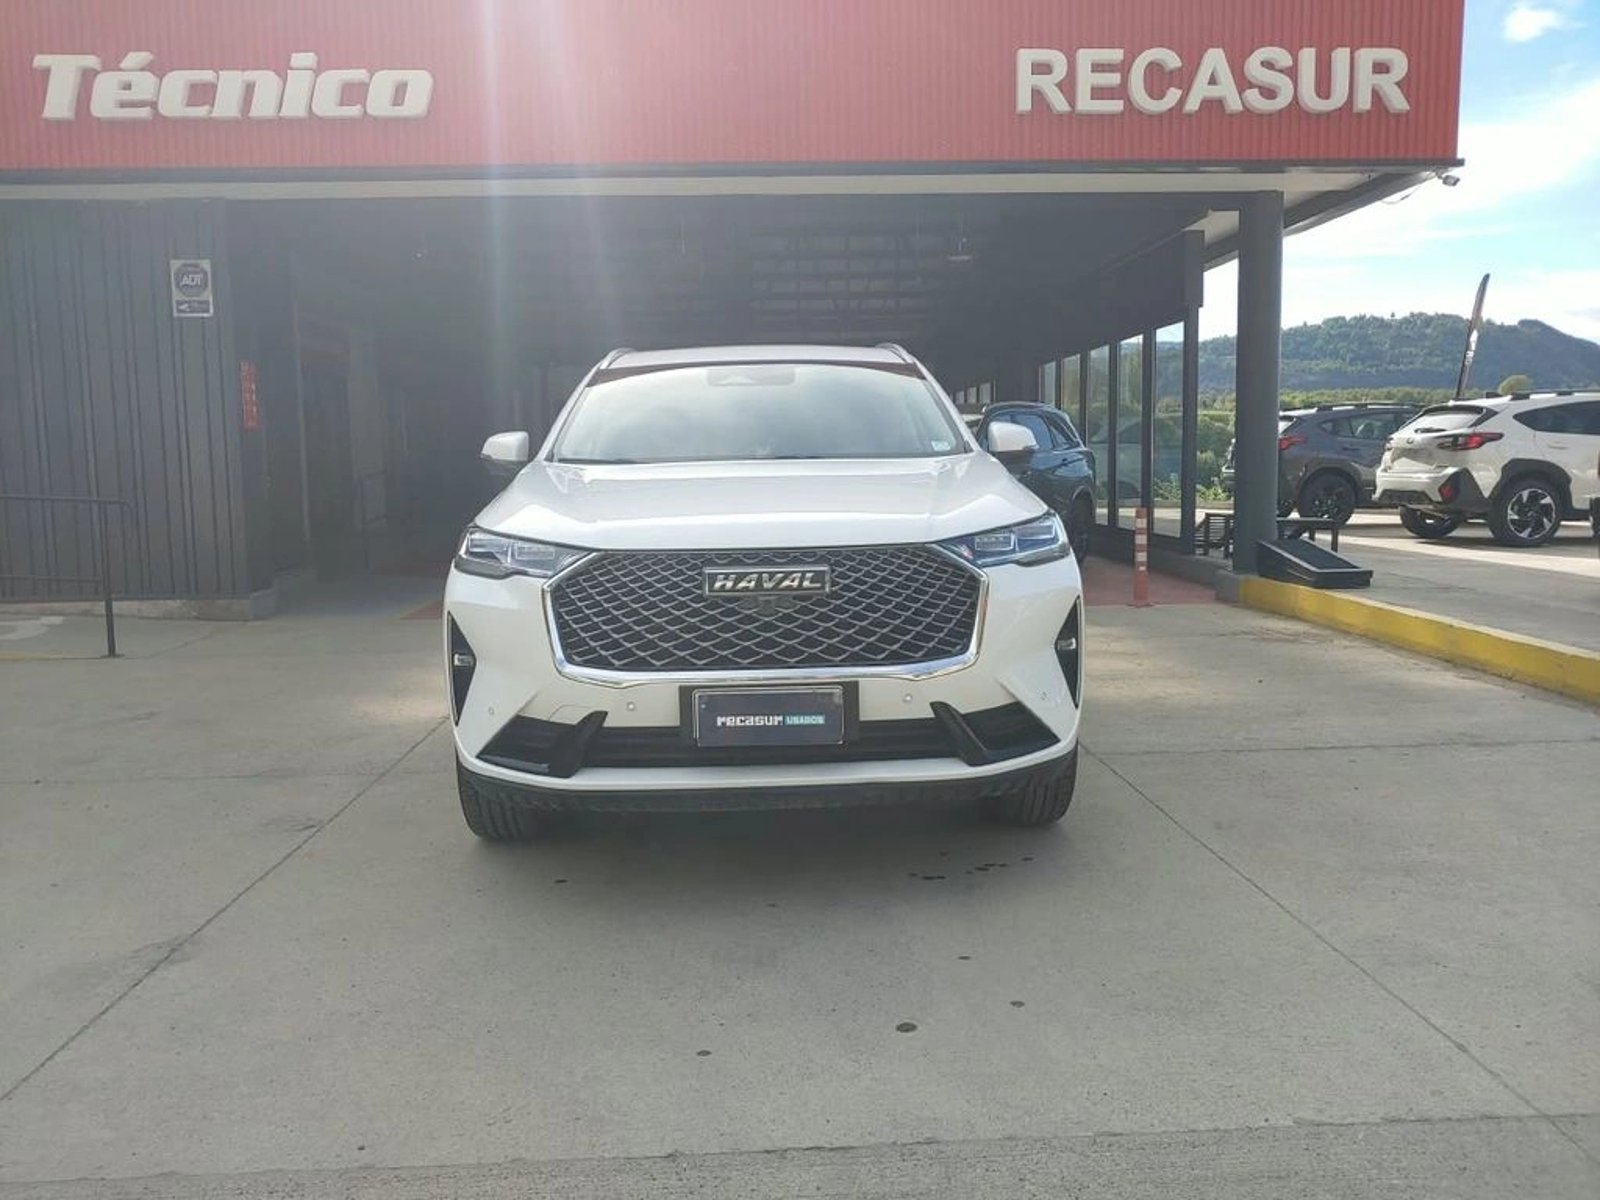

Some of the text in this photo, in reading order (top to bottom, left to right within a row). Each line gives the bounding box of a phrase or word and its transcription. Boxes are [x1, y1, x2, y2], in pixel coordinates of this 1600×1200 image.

[32, 51, 434, 121] Técnico
[1015, 46, 1411, 115] RECASUR
[180, 274, 203, 286] ADT
[713, 572, 822, 591] HAVAL
[716, 715, 783, 727] recasur
